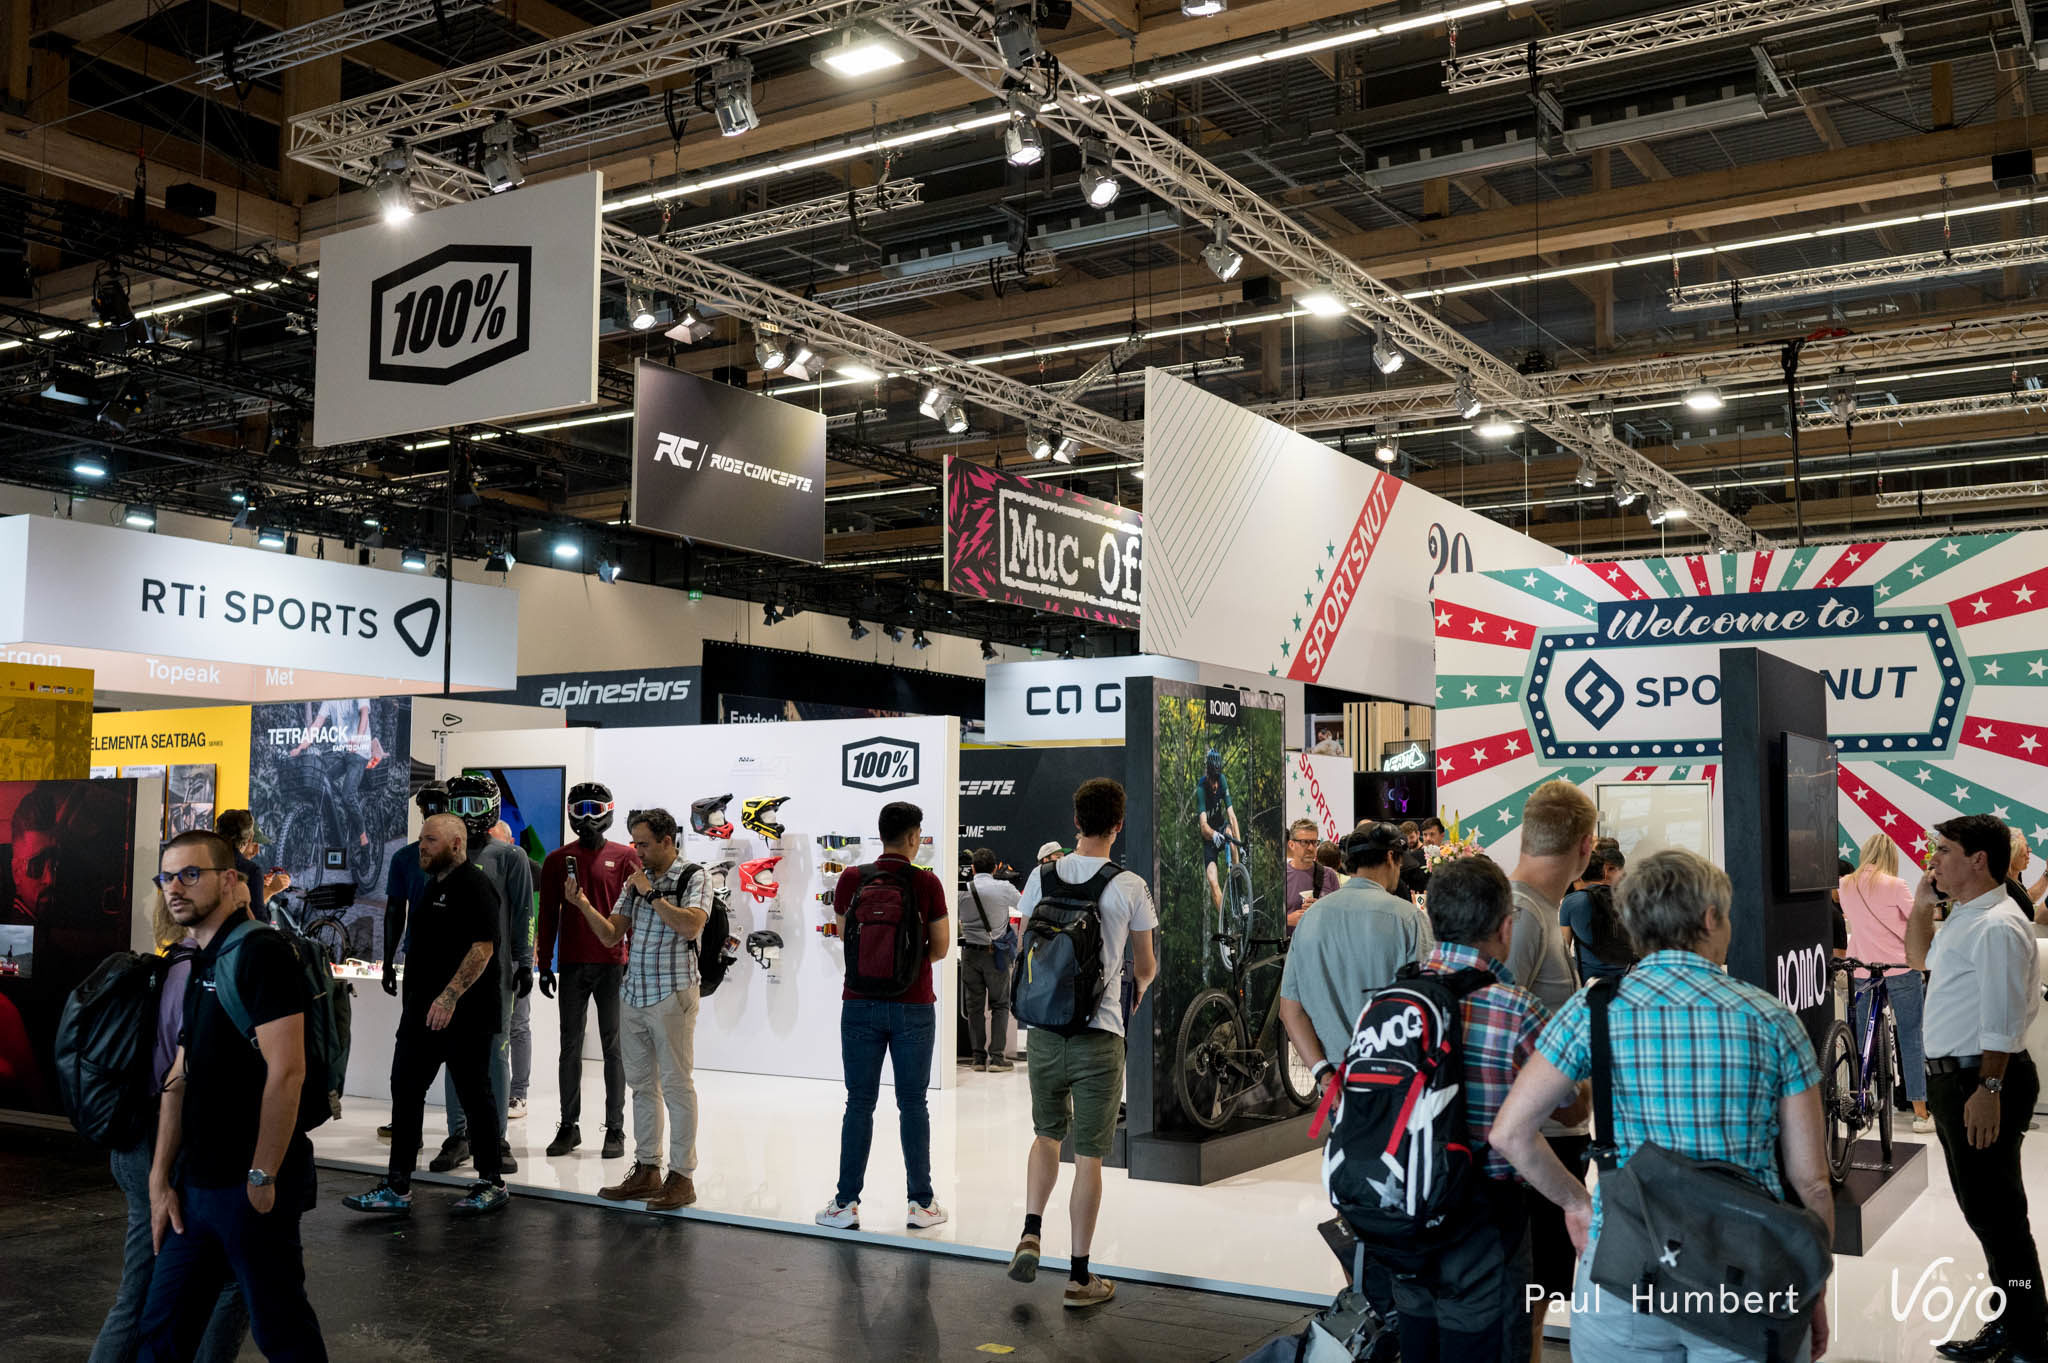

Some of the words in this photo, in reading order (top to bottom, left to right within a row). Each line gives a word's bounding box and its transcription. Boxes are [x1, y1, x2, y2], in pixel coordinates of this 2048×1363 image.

[391, 270, 508, 357] 100%
[653, 431, 700, 470] RC
[709, 453, 745, 475] RIDE
[1008, 507, 1142, 602] Muc-Of
[1305, 475, 1389, 677] SPORTSNUT
[141, 577, 206, 619] RTi
[224, 590, 378, 639] SPORTS
[1607, 604, 1810, 641] Welcome
[1817, 596, 1865, 629] to
[0, 645, 62, 667] rgon
[146, 658, 221, 684] Topeak
[265, 668, 295, 687] Met
[540, 677, 691, 709] alpinestars
[151, 731, 206, 748] SEATBAG
[267, 725, 348, 745] TETRARACK
[852, 750, 908, 778] 100%
